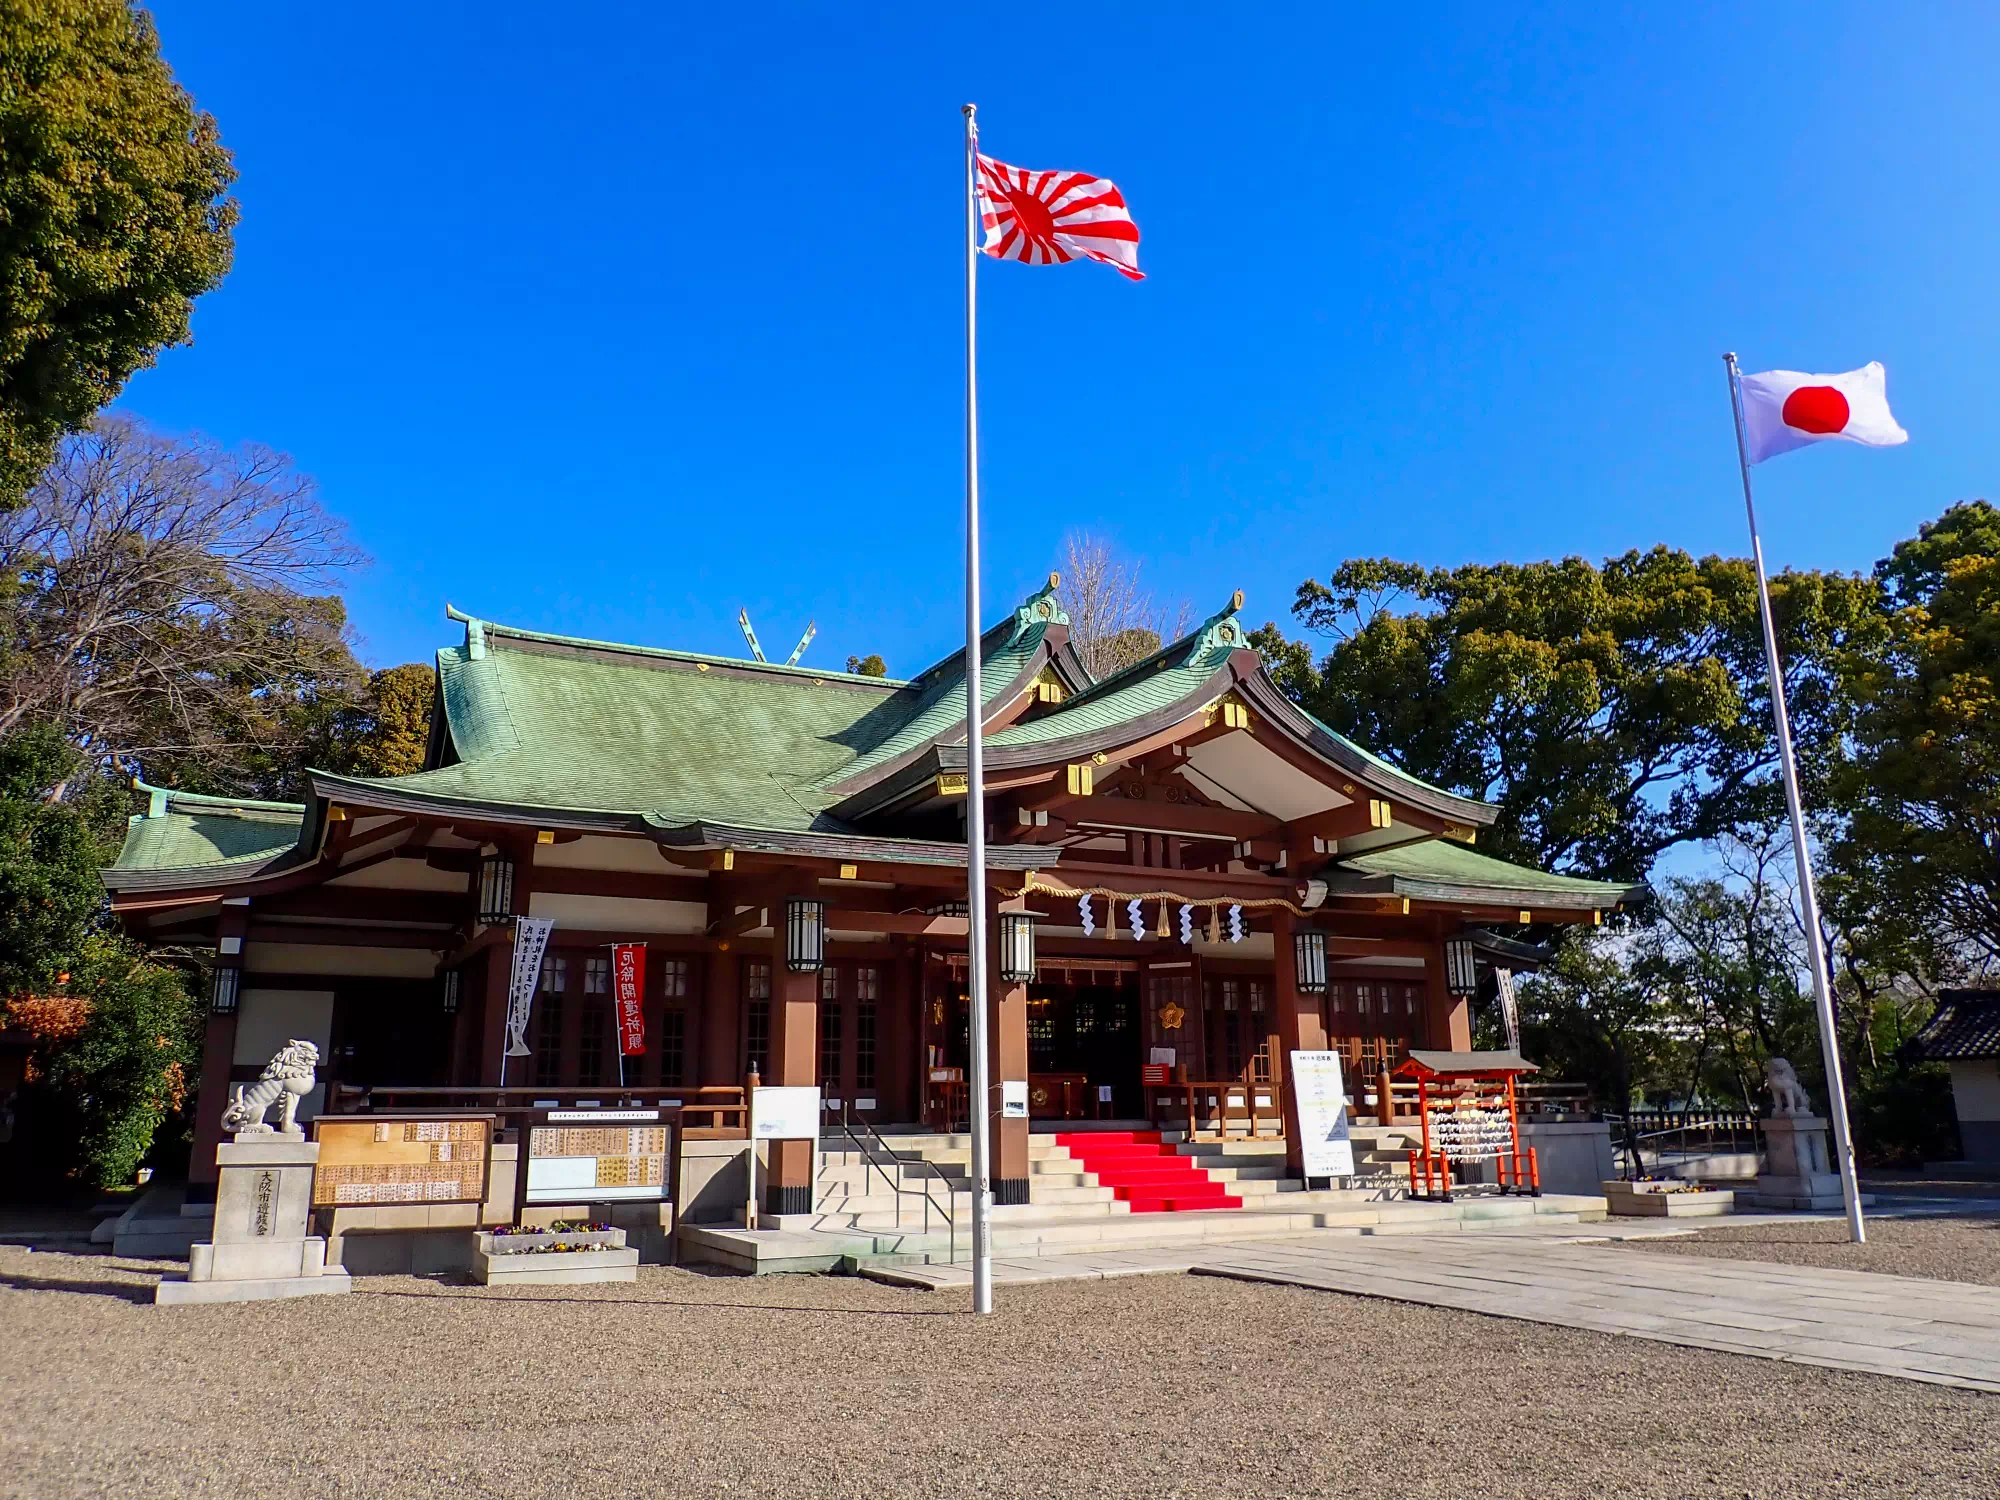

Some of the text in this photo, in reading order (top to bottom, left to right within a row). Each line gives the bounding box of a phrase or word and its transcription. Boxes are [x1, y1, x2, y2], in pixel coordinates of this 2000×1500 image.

[255, 1171, 272, 1236] 大阪市遺族会
